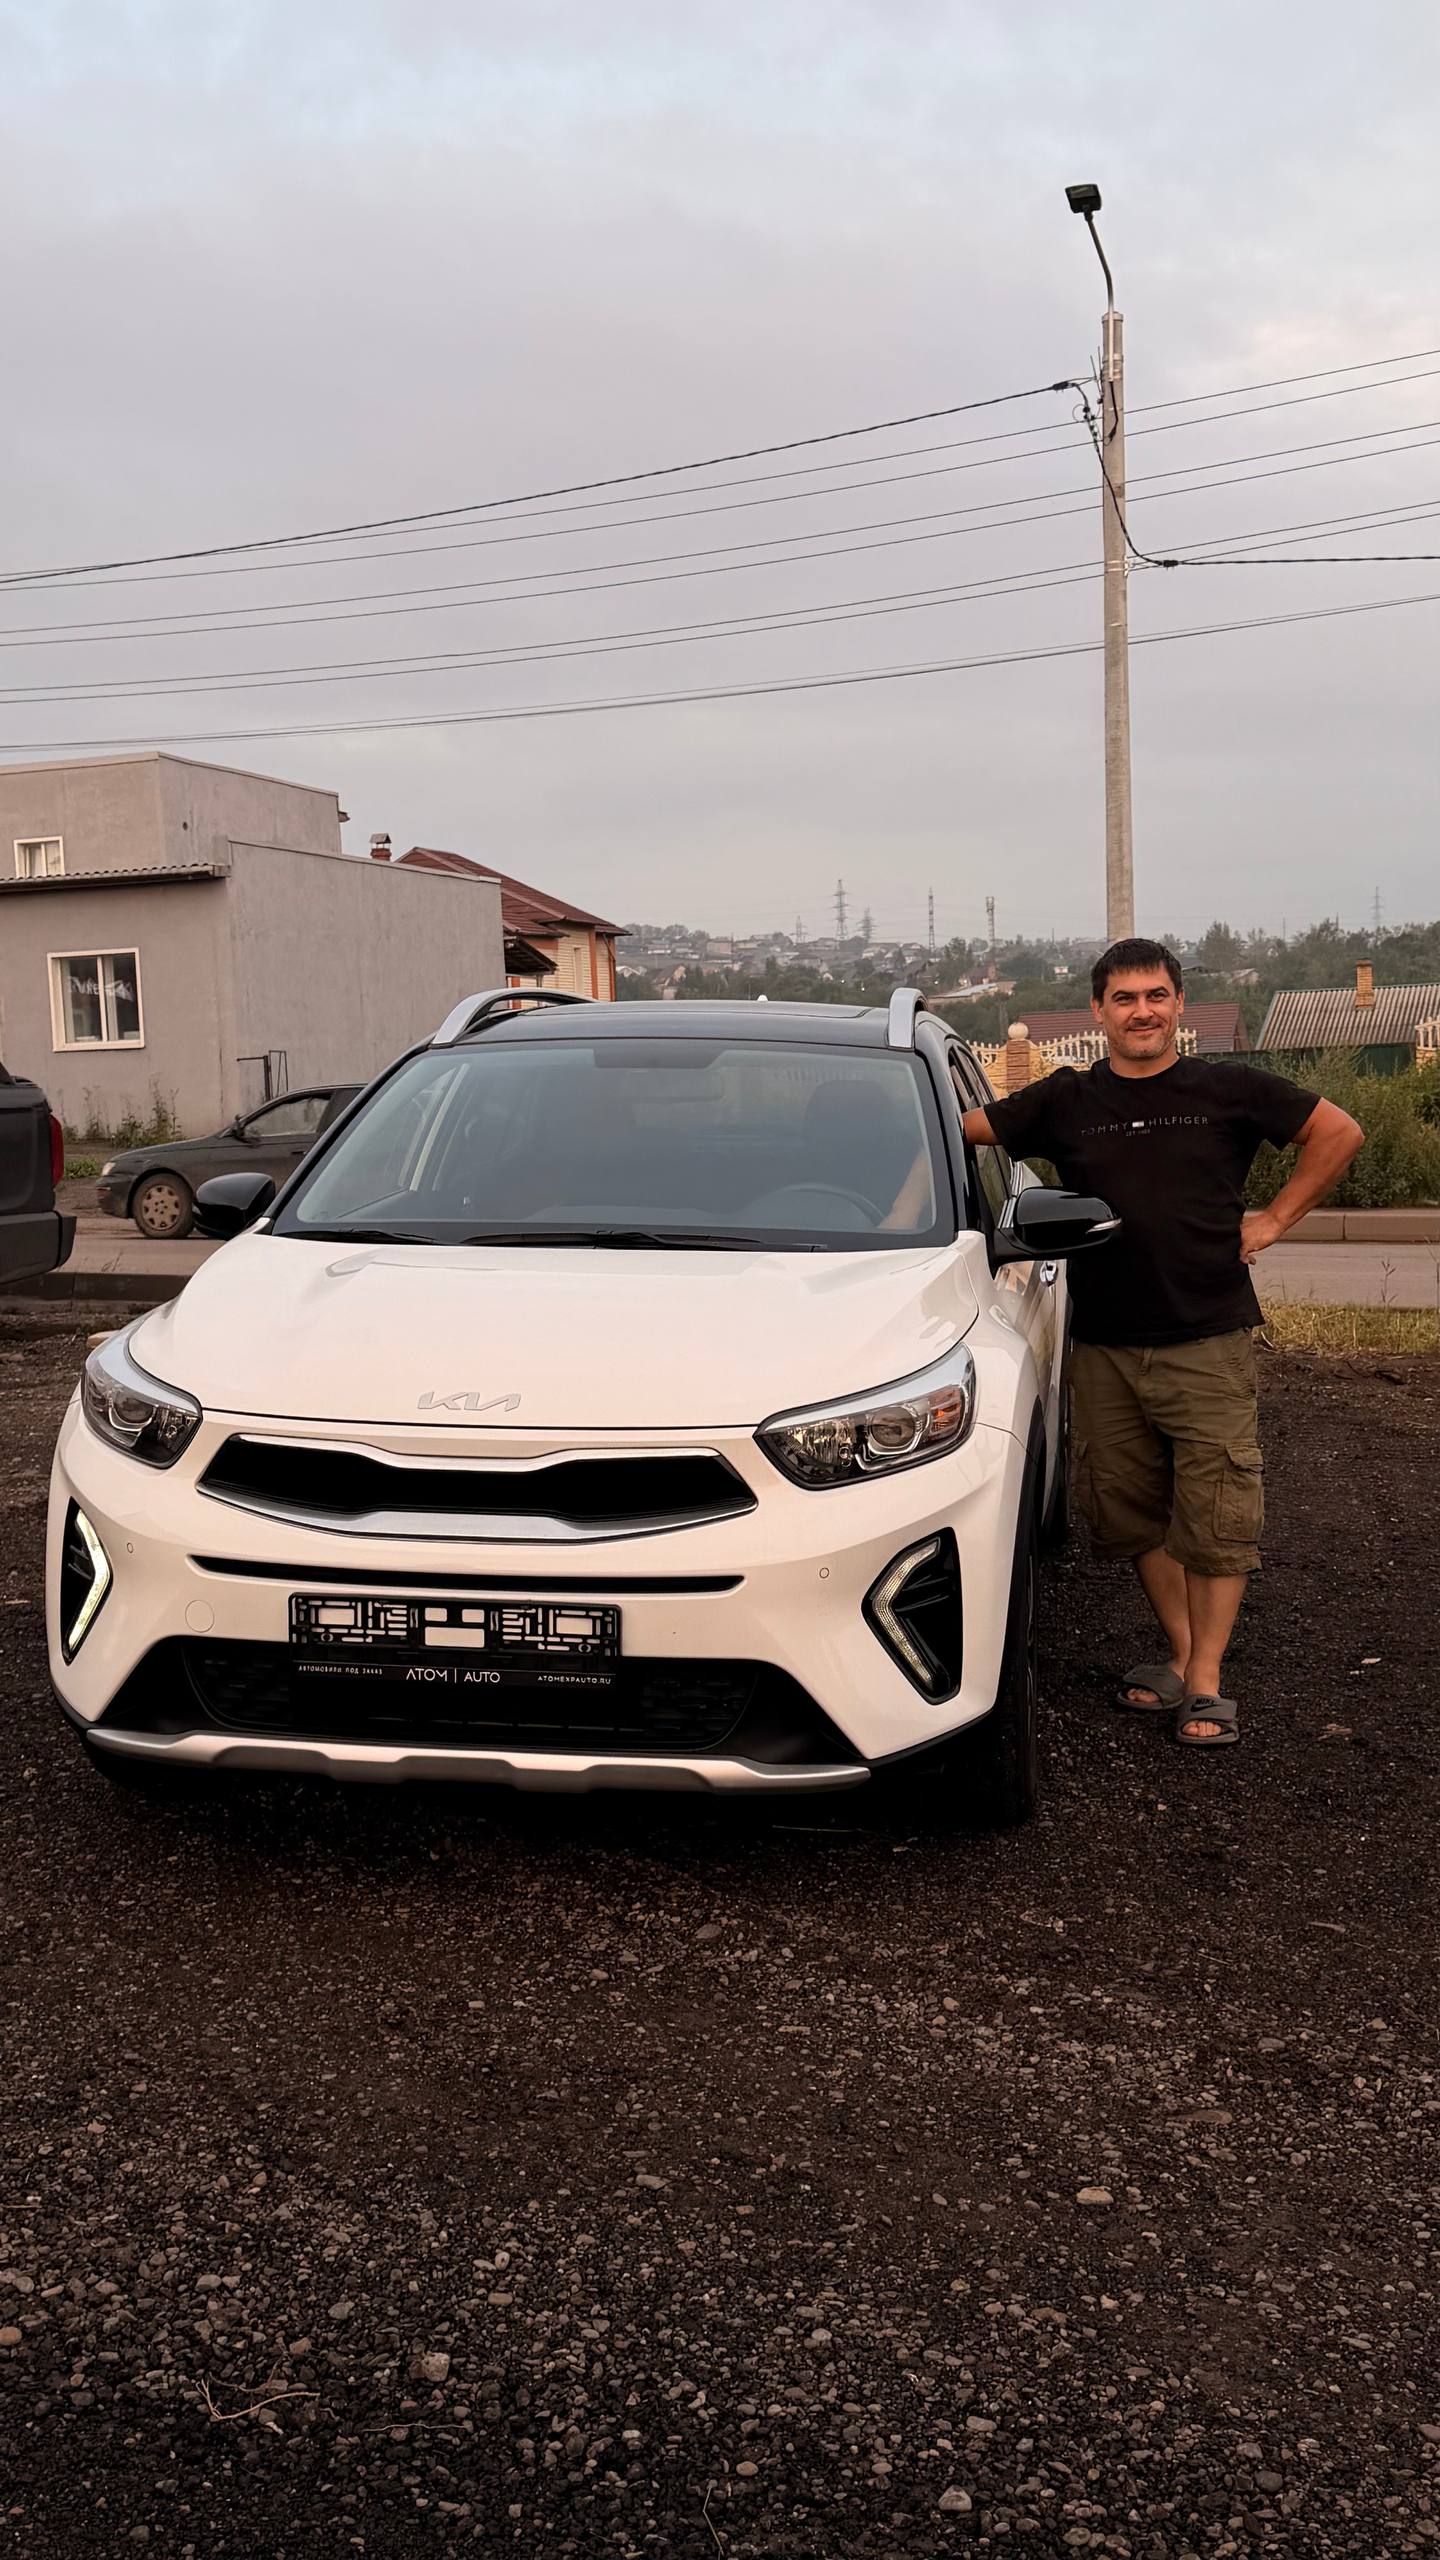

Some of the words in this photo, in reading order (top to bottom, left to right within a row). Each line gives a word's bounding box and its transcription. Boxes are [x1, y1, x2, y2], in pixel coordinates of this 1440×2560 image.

[1081, 1121, 1128, 1137] TOMMY
[1149, 1116, 1208, 1127] HILFIGER
[417, 1391, 522, 1412] KIA
[406, 1668, 448, 1682] ATOM
[463, 1671, 501, 1683] AUTO
